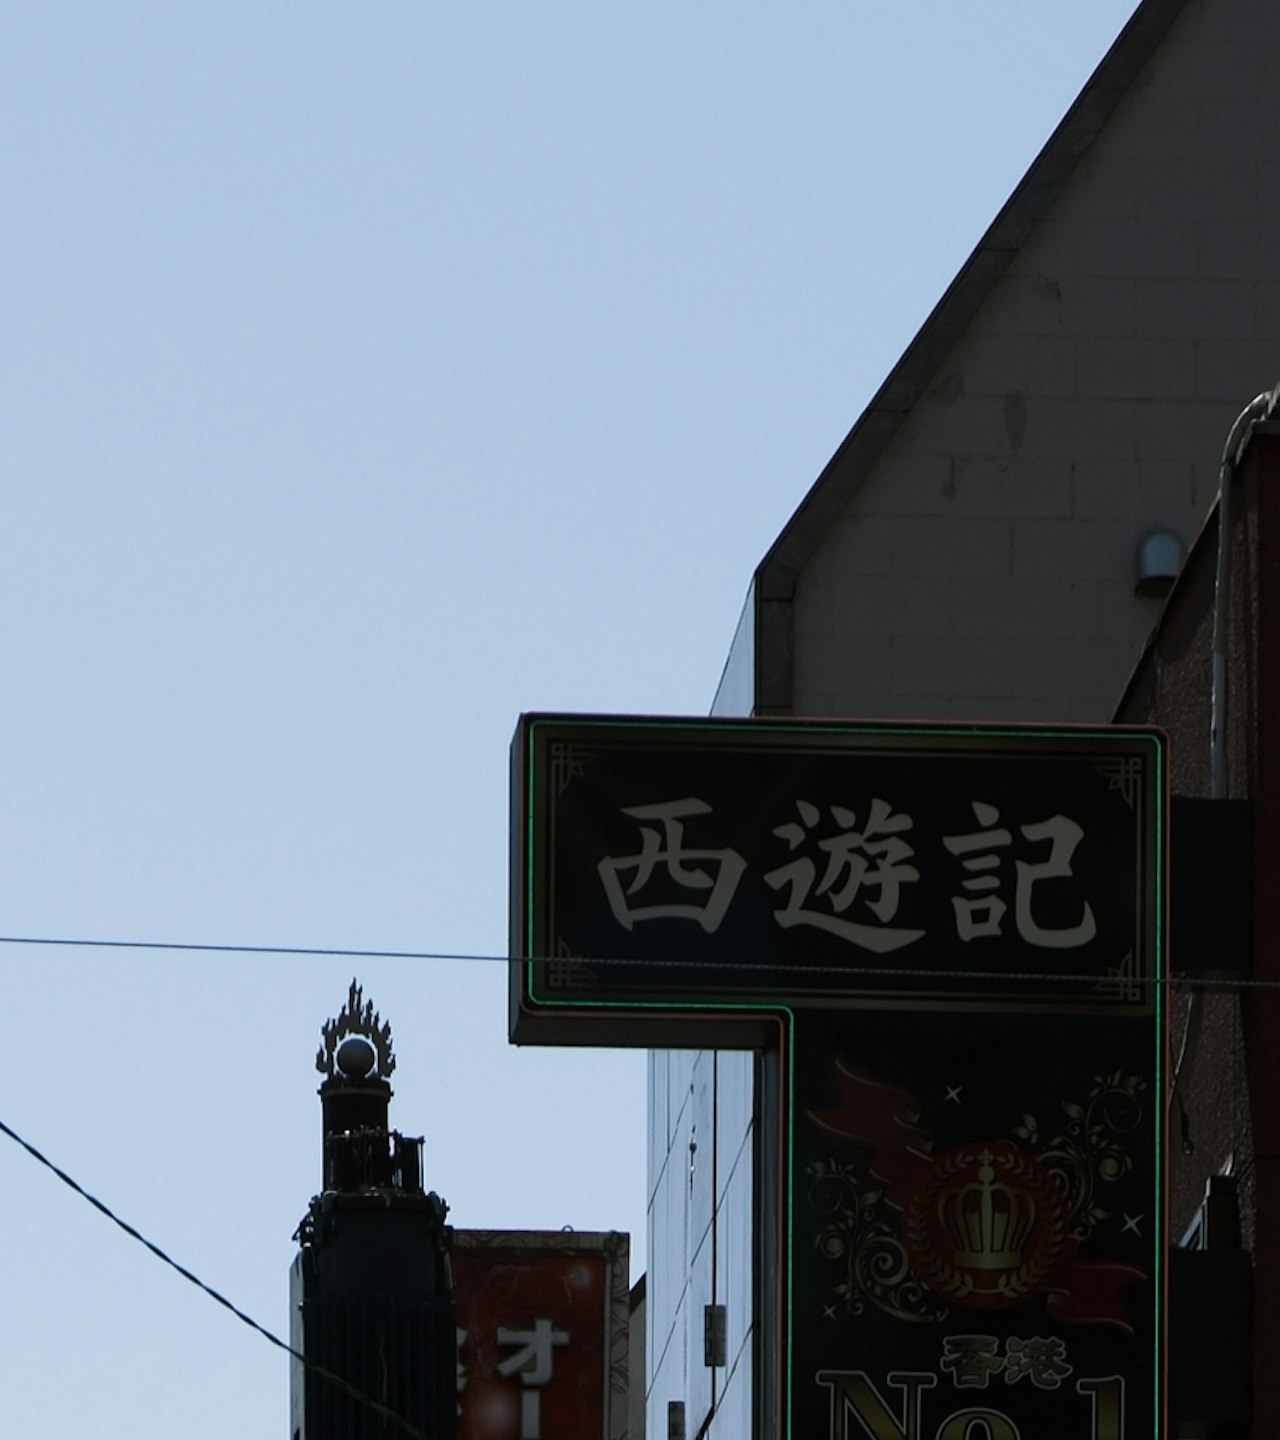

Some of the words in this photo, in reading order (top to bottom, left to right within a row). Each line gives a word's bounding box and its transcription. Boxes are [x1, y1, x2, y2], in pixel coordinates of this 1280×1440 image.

[597, 797, 1097, 954] 西遊記
[941, 1335, 1073, 1389] 香港
